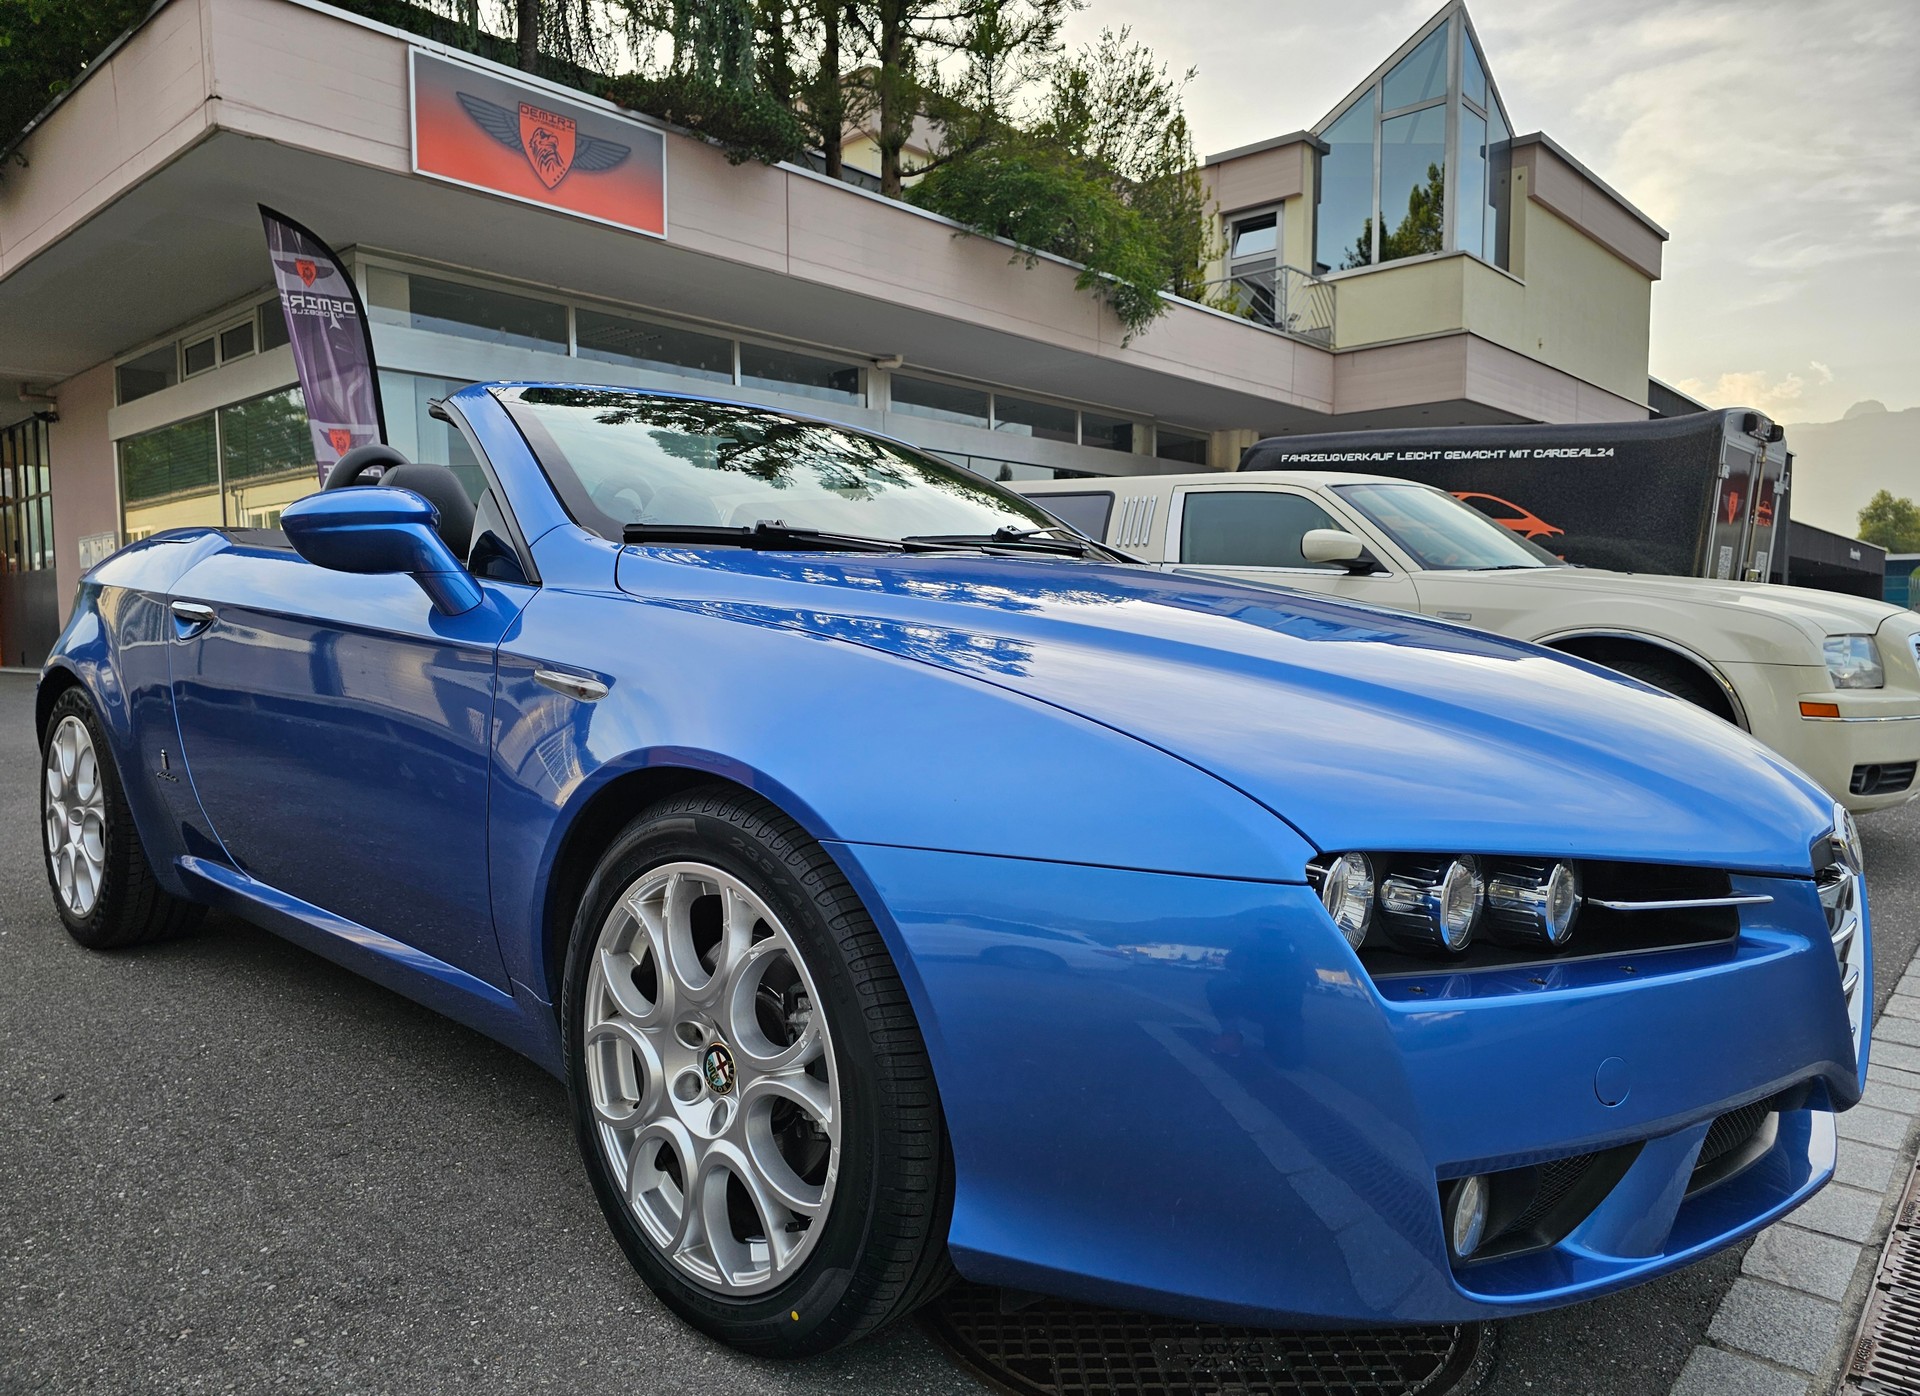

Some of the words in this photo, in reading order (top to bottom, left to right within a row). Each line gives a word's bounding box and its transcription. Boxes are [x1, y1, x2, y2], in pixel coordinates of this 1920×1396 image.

[520, 104, 575, 130] DEMIRI
[1281, 452, 1394, 463] FAHRZEUGVERKAUF
[1397, 451, 1442, 461] LEICHT
[1444, 450, 1506, 460] GEMACHT
[1509, 449, 1531, 459] MIT
[1533, 448, 1615, 458] CARDEAL24
